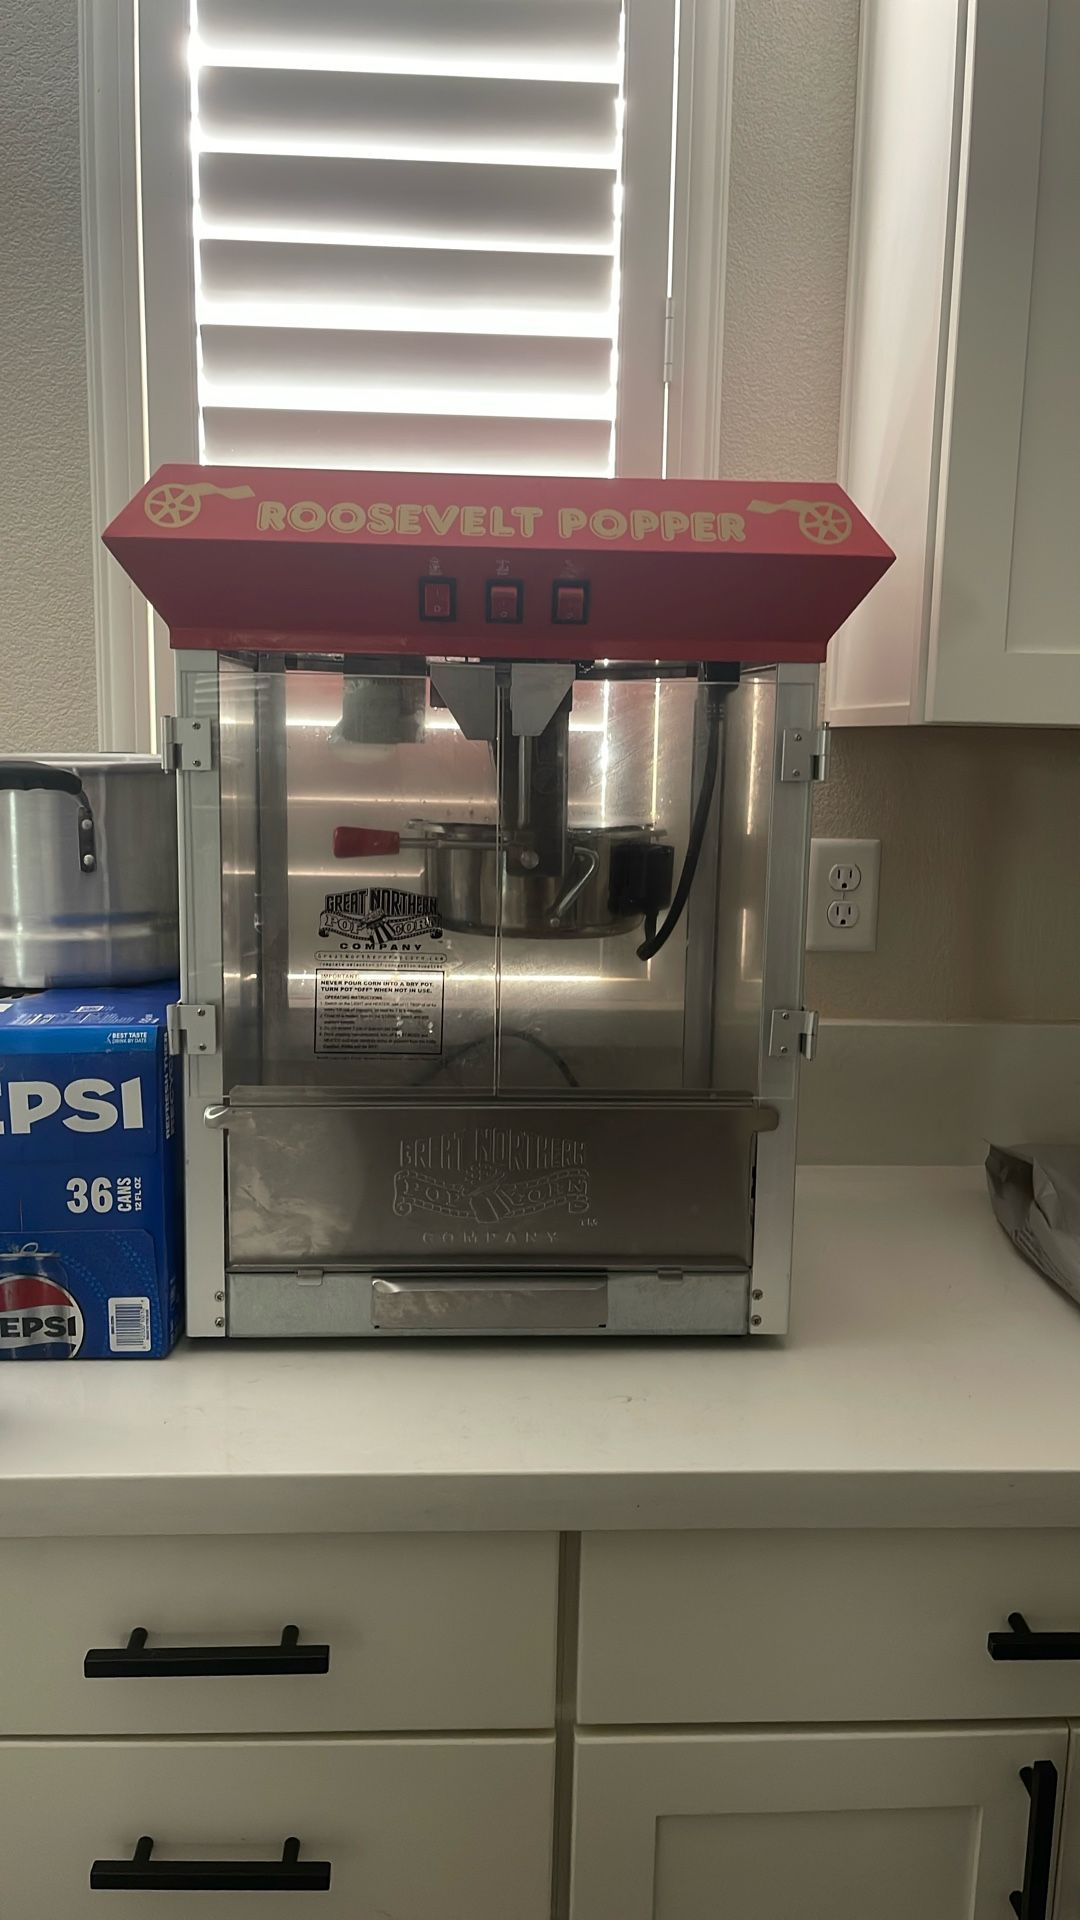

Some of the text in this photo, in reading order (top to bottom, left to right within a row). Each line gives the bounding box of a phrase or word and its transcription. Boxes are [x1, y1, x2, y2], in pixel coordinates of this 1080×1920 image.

[256, 501, 746, 542] ROOSEVELT POPPER
[325, 887, 437, 916] GREAT NORTHERN
[340, 943, 422, 951] COMPANY
[0, 1077, 144, 1135] PSI
[66, 1177, 113, 1214] 36
[117, 1177, 132, 1212] CANS
[134, 1176, 141, 1211] 12 FL OZ
[422, 1231, 559, 1244] COMPANY
